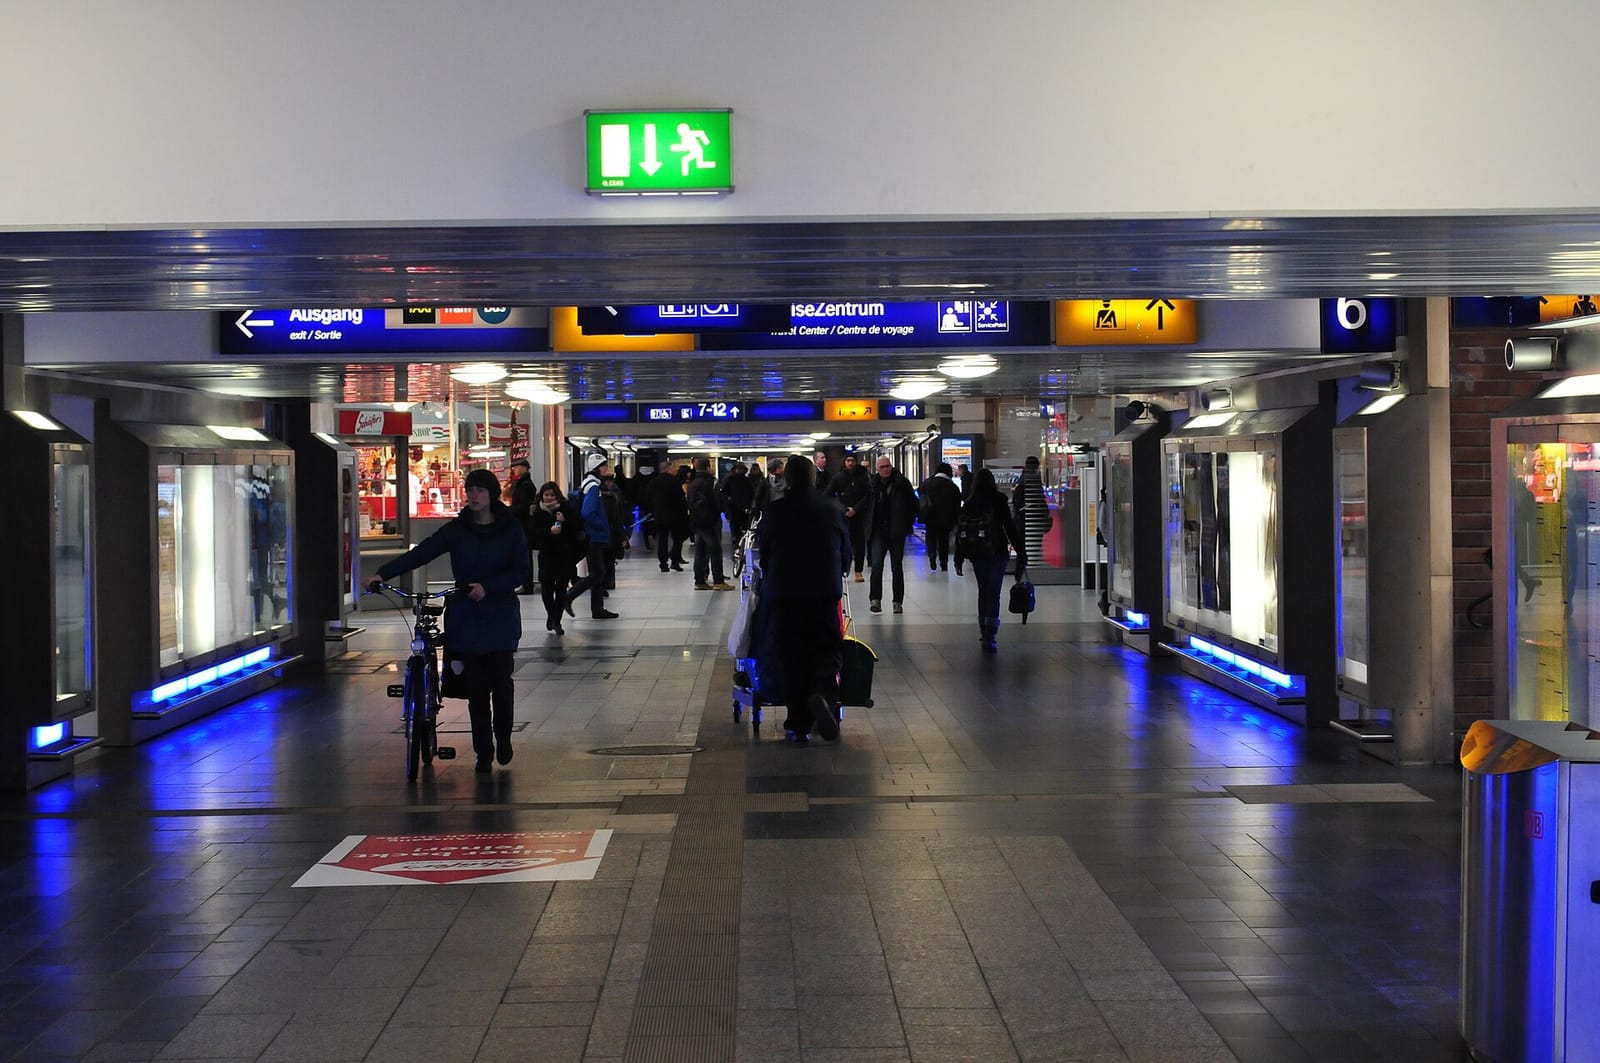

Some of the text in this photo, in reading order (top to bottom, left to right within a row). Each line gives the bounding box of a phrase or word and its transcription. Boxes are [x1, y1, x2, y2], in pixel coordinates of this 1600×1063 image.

[289, 308, 363, 325] Ausgang
[1337, 297, 1367, 330] 6
[289, 330, 307, 340] exit
[314, 329, 342, 340] Sortie
[799, 325, 829, 335] Center
[836, 325, 866, 335] Centre
[868, 324, 880, 335] de
[882, 326, 914, 336] voyage
[698, 402, 727, 417] 7-12
